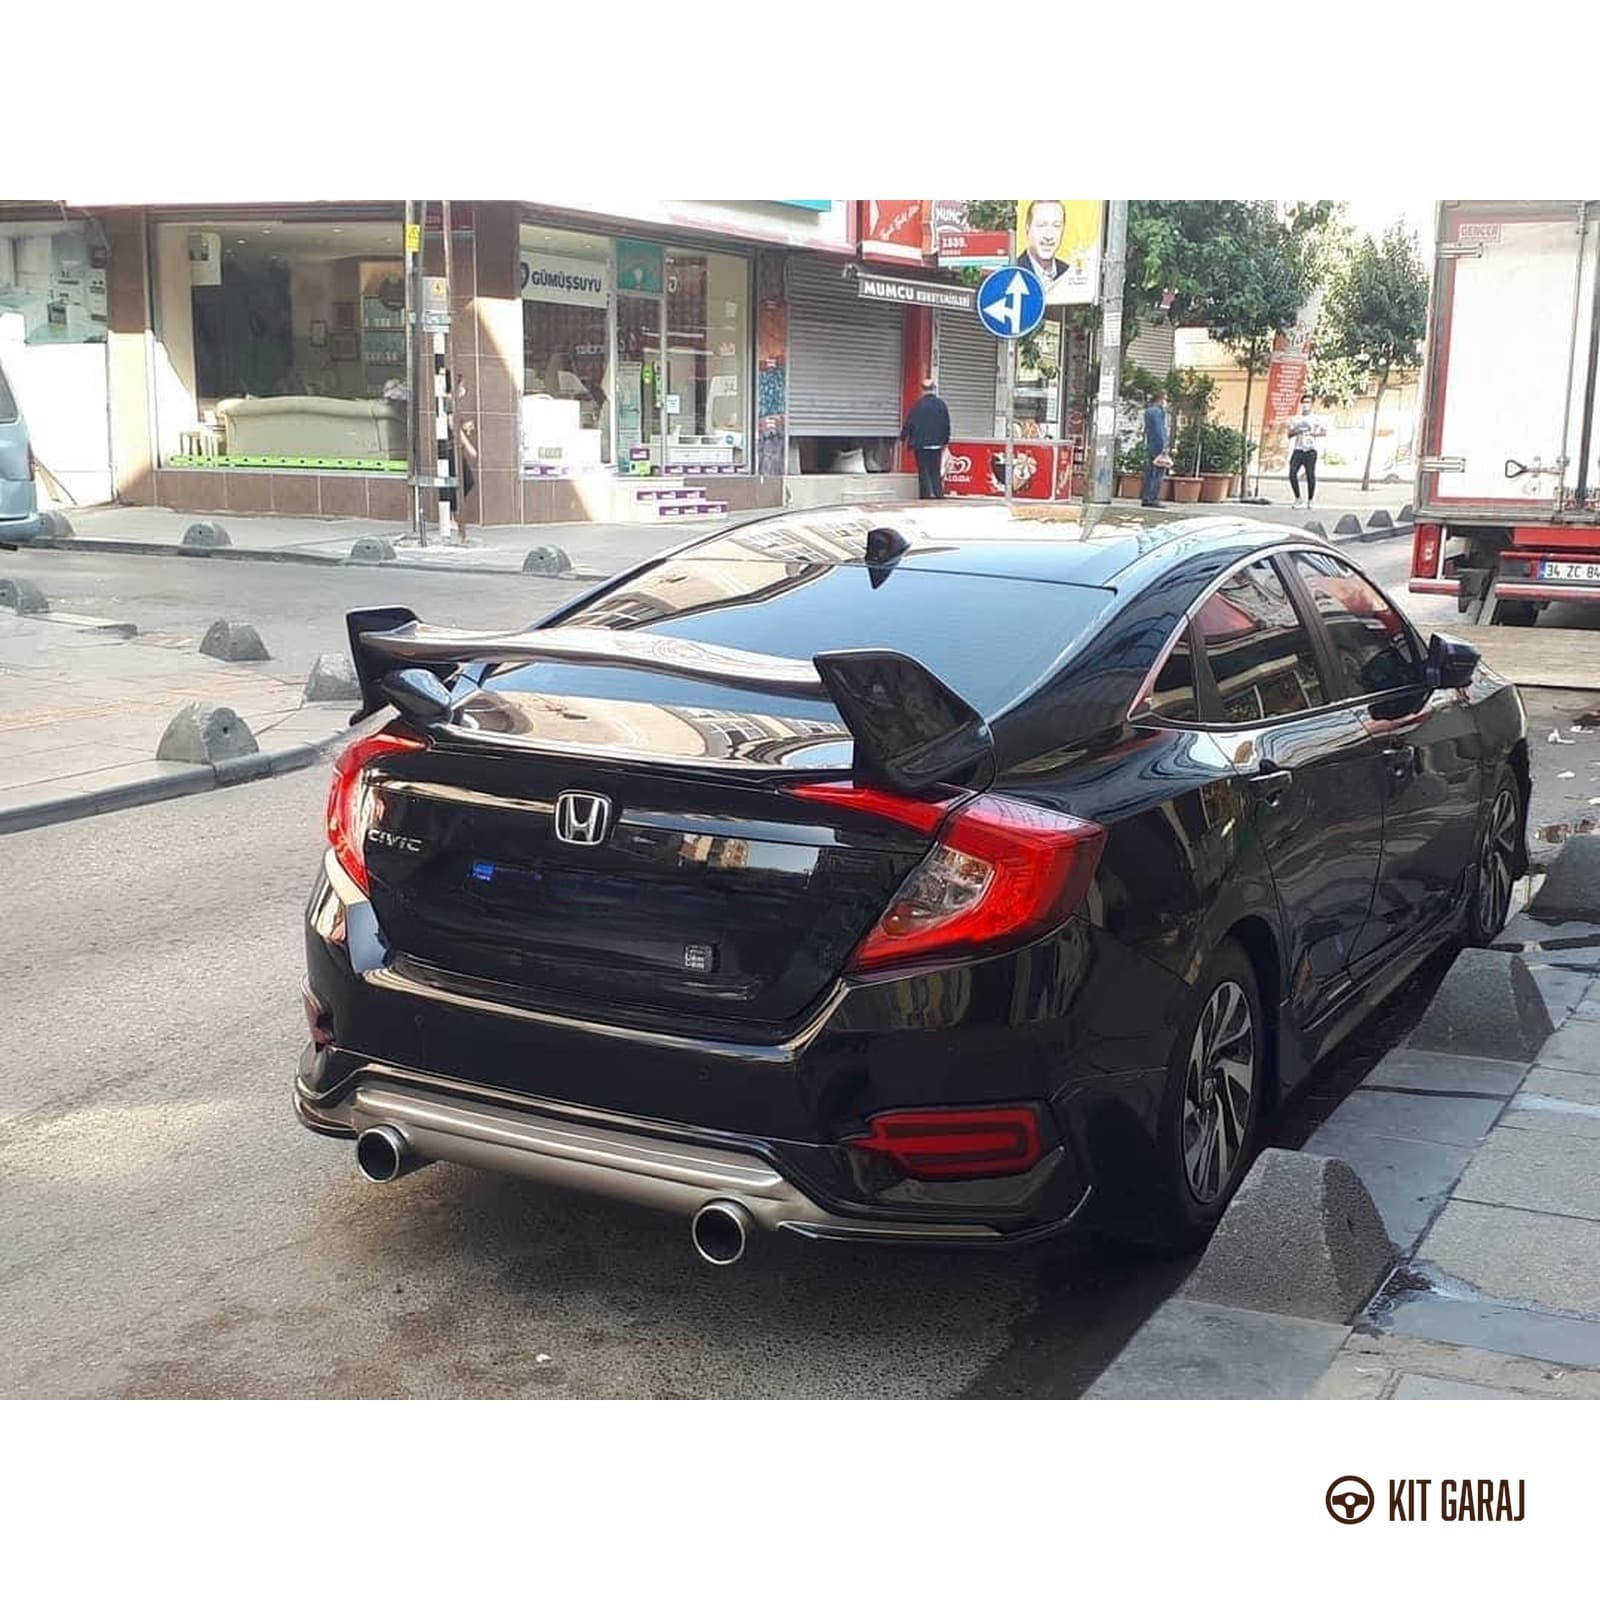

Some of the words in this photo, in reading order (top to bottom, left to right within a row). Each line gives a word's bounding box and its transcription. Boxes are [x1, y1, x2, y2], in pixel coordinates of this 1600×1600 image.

[531, 268, 602, 293] GÜMÜŞSUYU
[864, 281, 914, 300] MUMCU
[1546, 564, 1560, 577] 34
[1567, 565, 1581, 578] ZC
[367, 827, 423, 852] CIVIC
